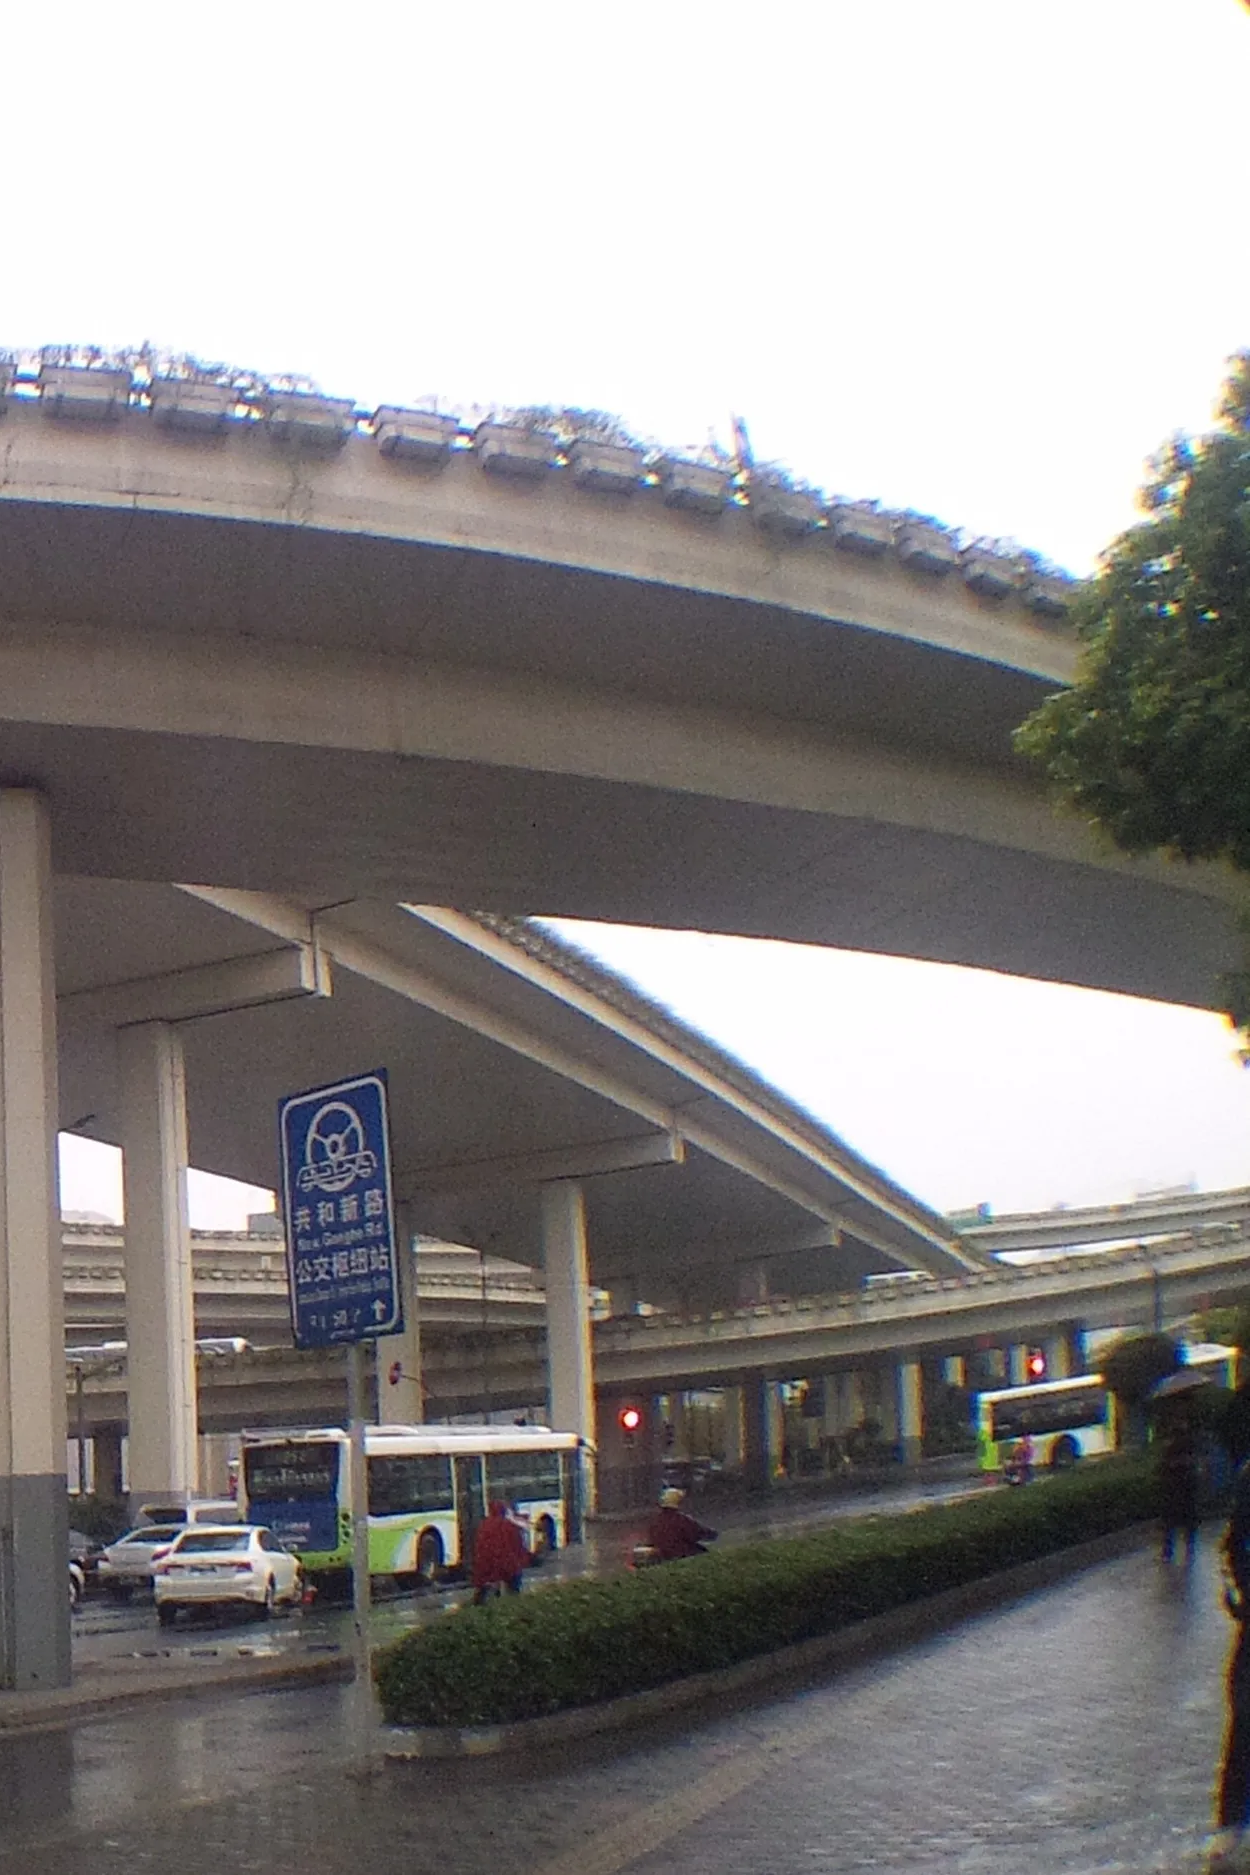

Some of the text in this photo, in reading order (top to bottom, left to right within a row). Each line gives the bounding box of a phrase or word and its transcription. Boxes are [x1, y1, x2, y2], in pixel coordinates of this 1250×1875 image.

[294, 1189, 384, 1232] 共和新路
[296, 1243, 389, 1283] 公交枢纽站
